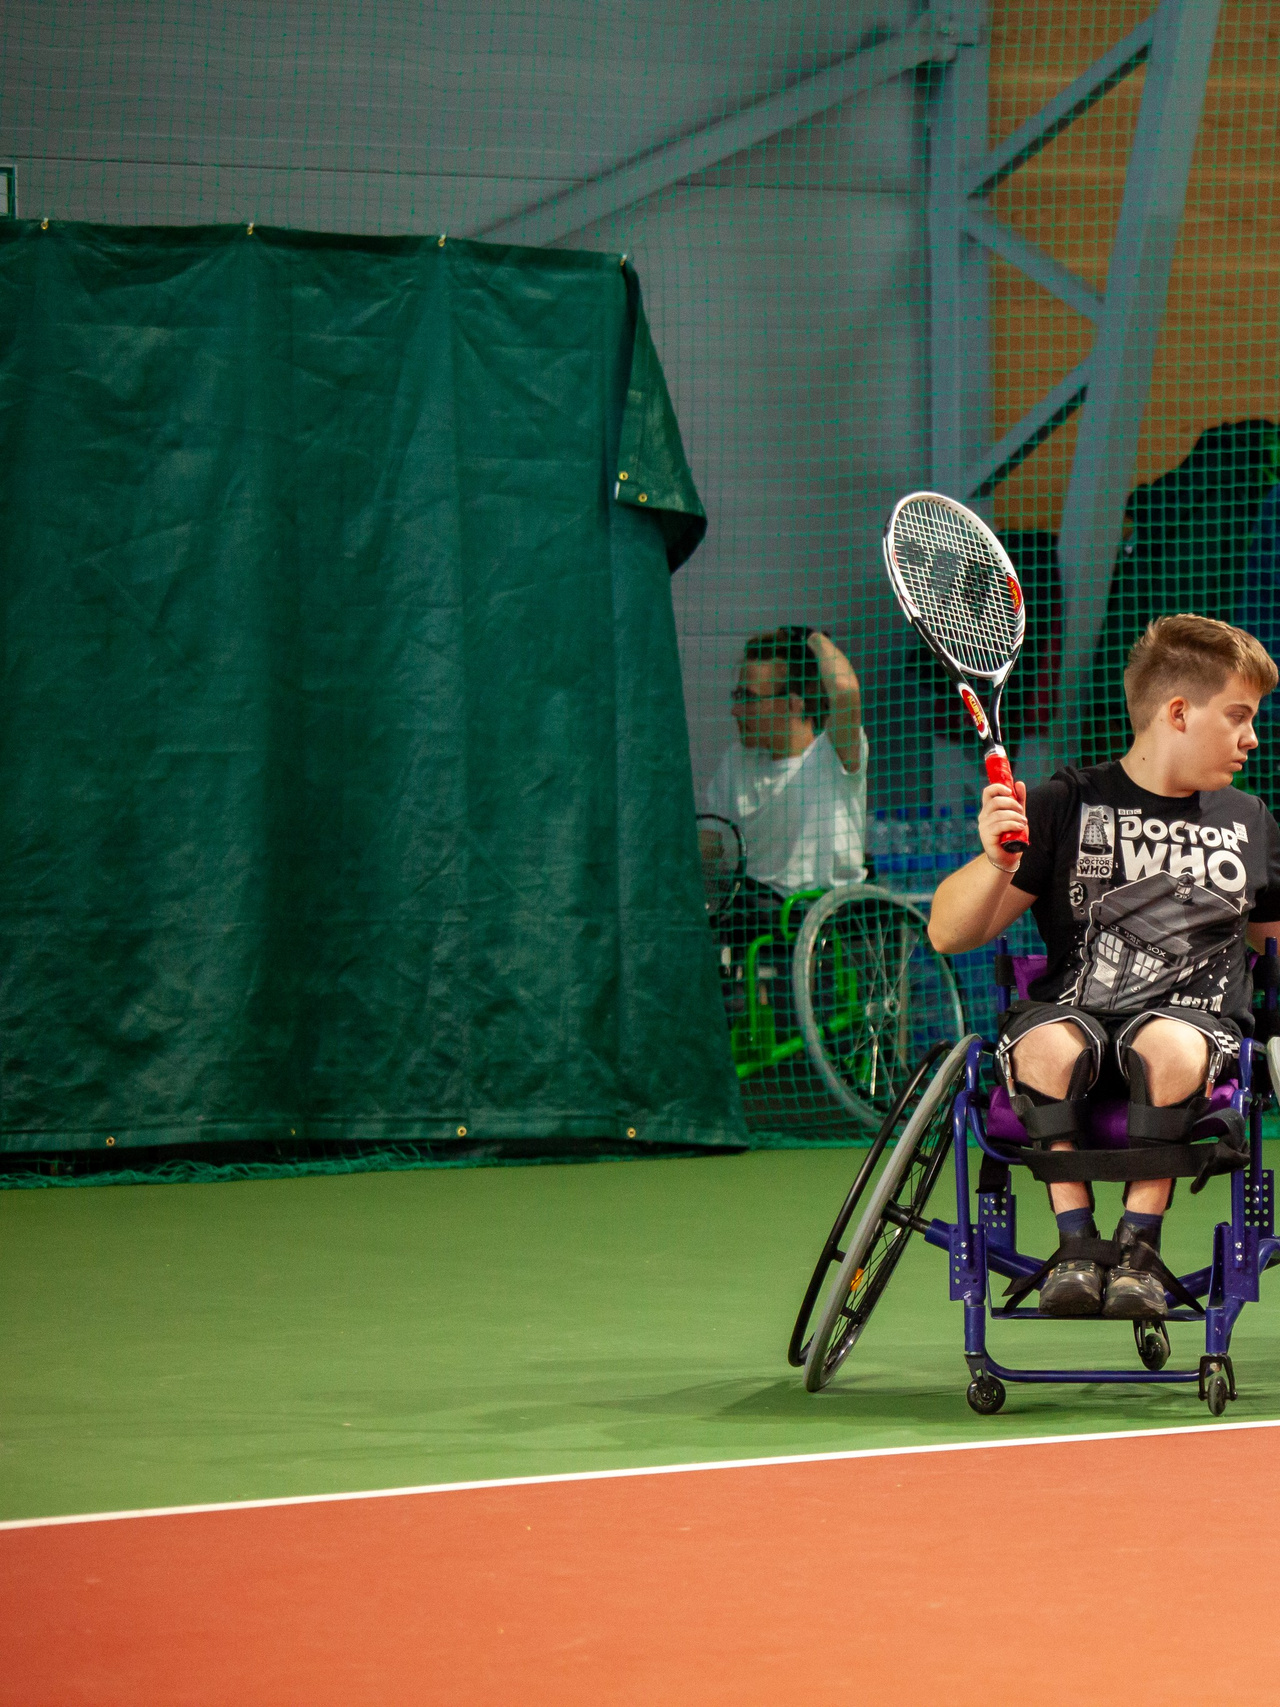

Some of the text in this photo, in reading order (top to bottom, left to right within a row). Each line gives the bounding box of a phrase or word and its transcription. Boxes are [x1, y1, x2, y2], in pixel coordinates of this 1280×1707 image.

[1119, 816, 1242, 852] DOCTOR
[1080, 865, 1110, 876] WHO
[1120, 839, 1247, 893] WHO
[1147, 944, 1167, 957] BOX
